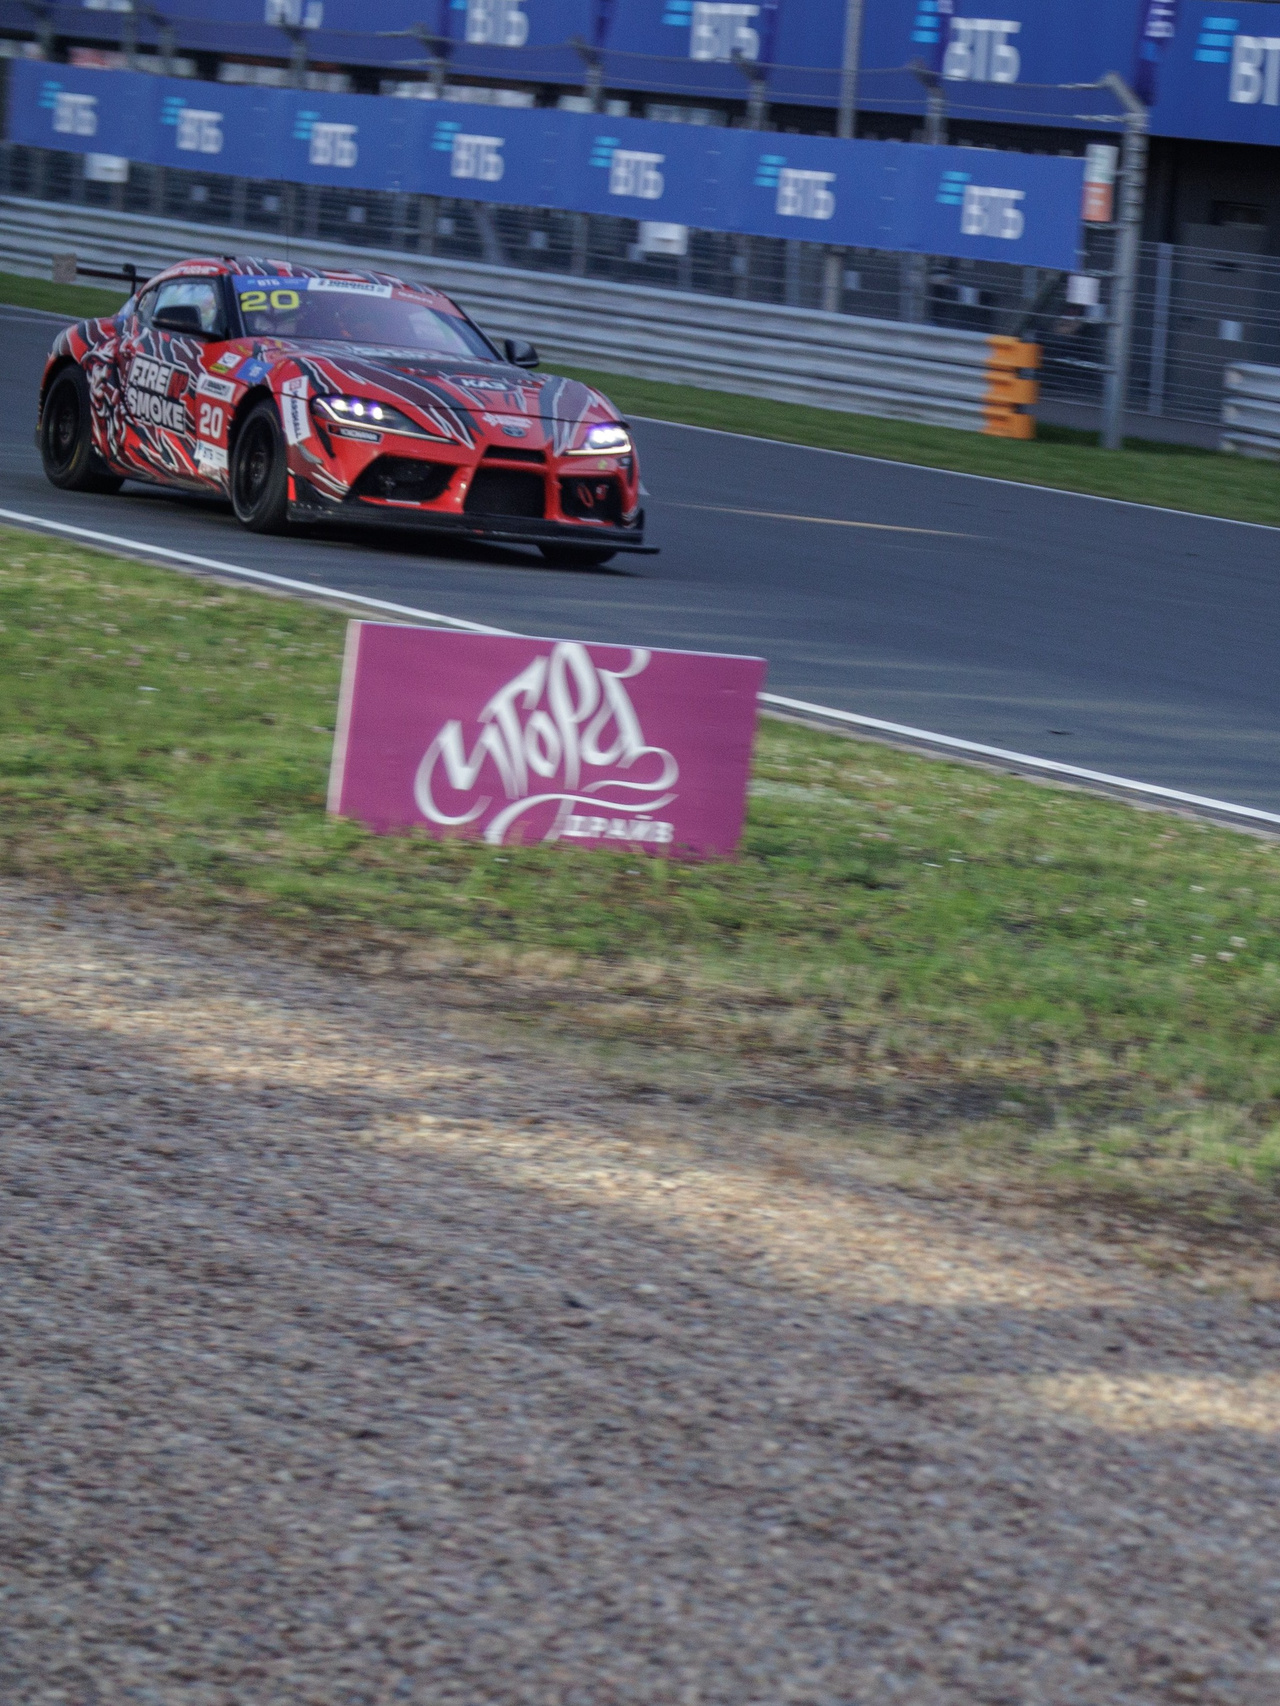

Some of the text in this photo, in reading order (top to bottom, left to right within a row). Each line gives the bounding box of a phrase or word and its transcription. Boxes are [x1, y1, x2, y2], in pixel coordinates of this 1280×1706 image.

[690, 2, 760, 62] ВТБ
[942, 17, 1021, 83] ВТБ
[609, 149, 665, 200] ВТБ
[776, 168, 836, 220] ВТБ
[961, 185, 1026, 239] ВТБ
[241, 290, 299, 312] 20
[130, 356, 170, 396] FIRE
[127, 387, 185, 433] SMOKE
[200, 402, 224, 439] 20
